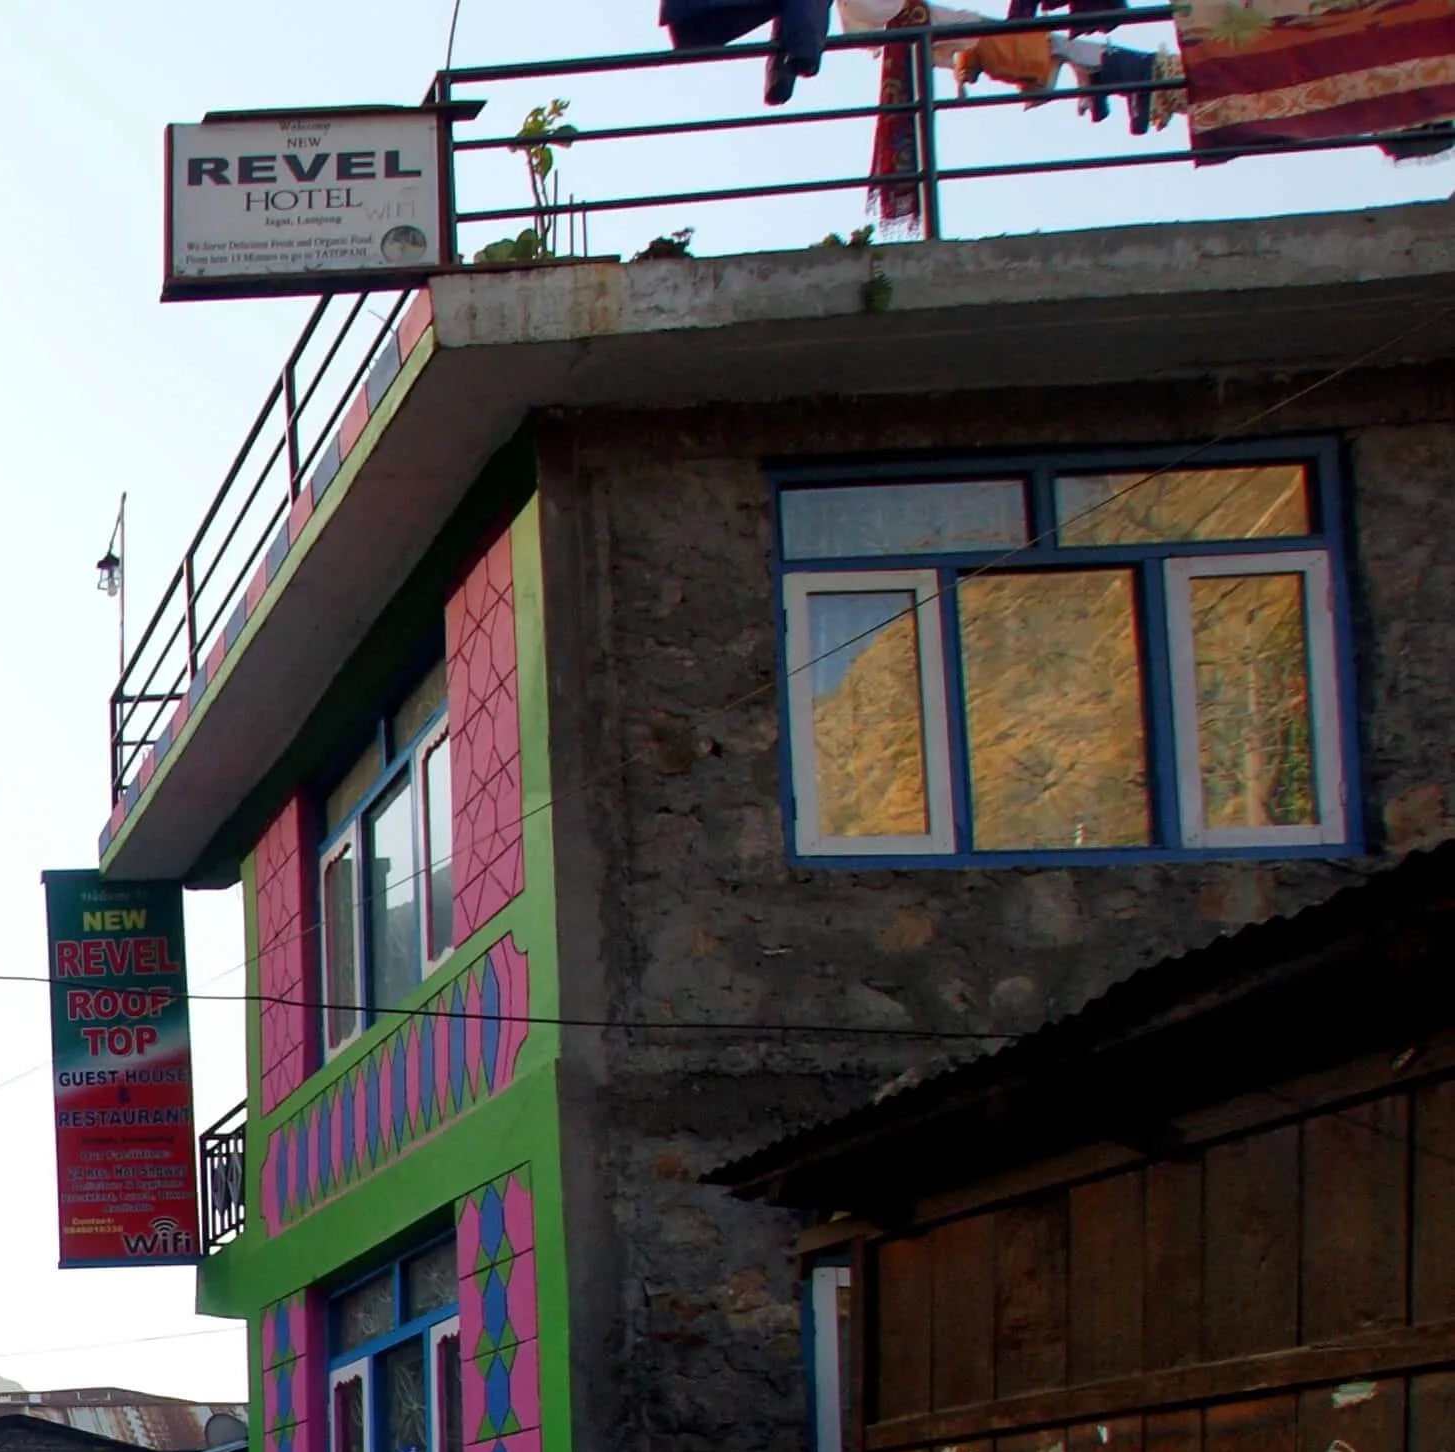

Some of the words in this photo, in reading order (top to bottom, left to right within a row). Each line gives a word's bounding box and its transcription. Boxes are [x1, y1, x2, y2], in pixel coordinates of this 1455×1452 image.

[287, 137, 322, 149] NEW
[187, 150, 422, 187] REVEL
[245, 187, 363, 212] HOTEL
[82, 909, 147, 932] NEW
[56, 936, 180, 978] REVEL
[67, 986, 175, 1022] ROOF
[82, 1025, 159, 1058] TOP
[58, 1070, 119, 1087] GUEST
[125, 1068, 188, 1085] HOUSE
[58, 1106, 192, 1128] RESTAURANT
[122, 1231, 194, 1256] Wifi
